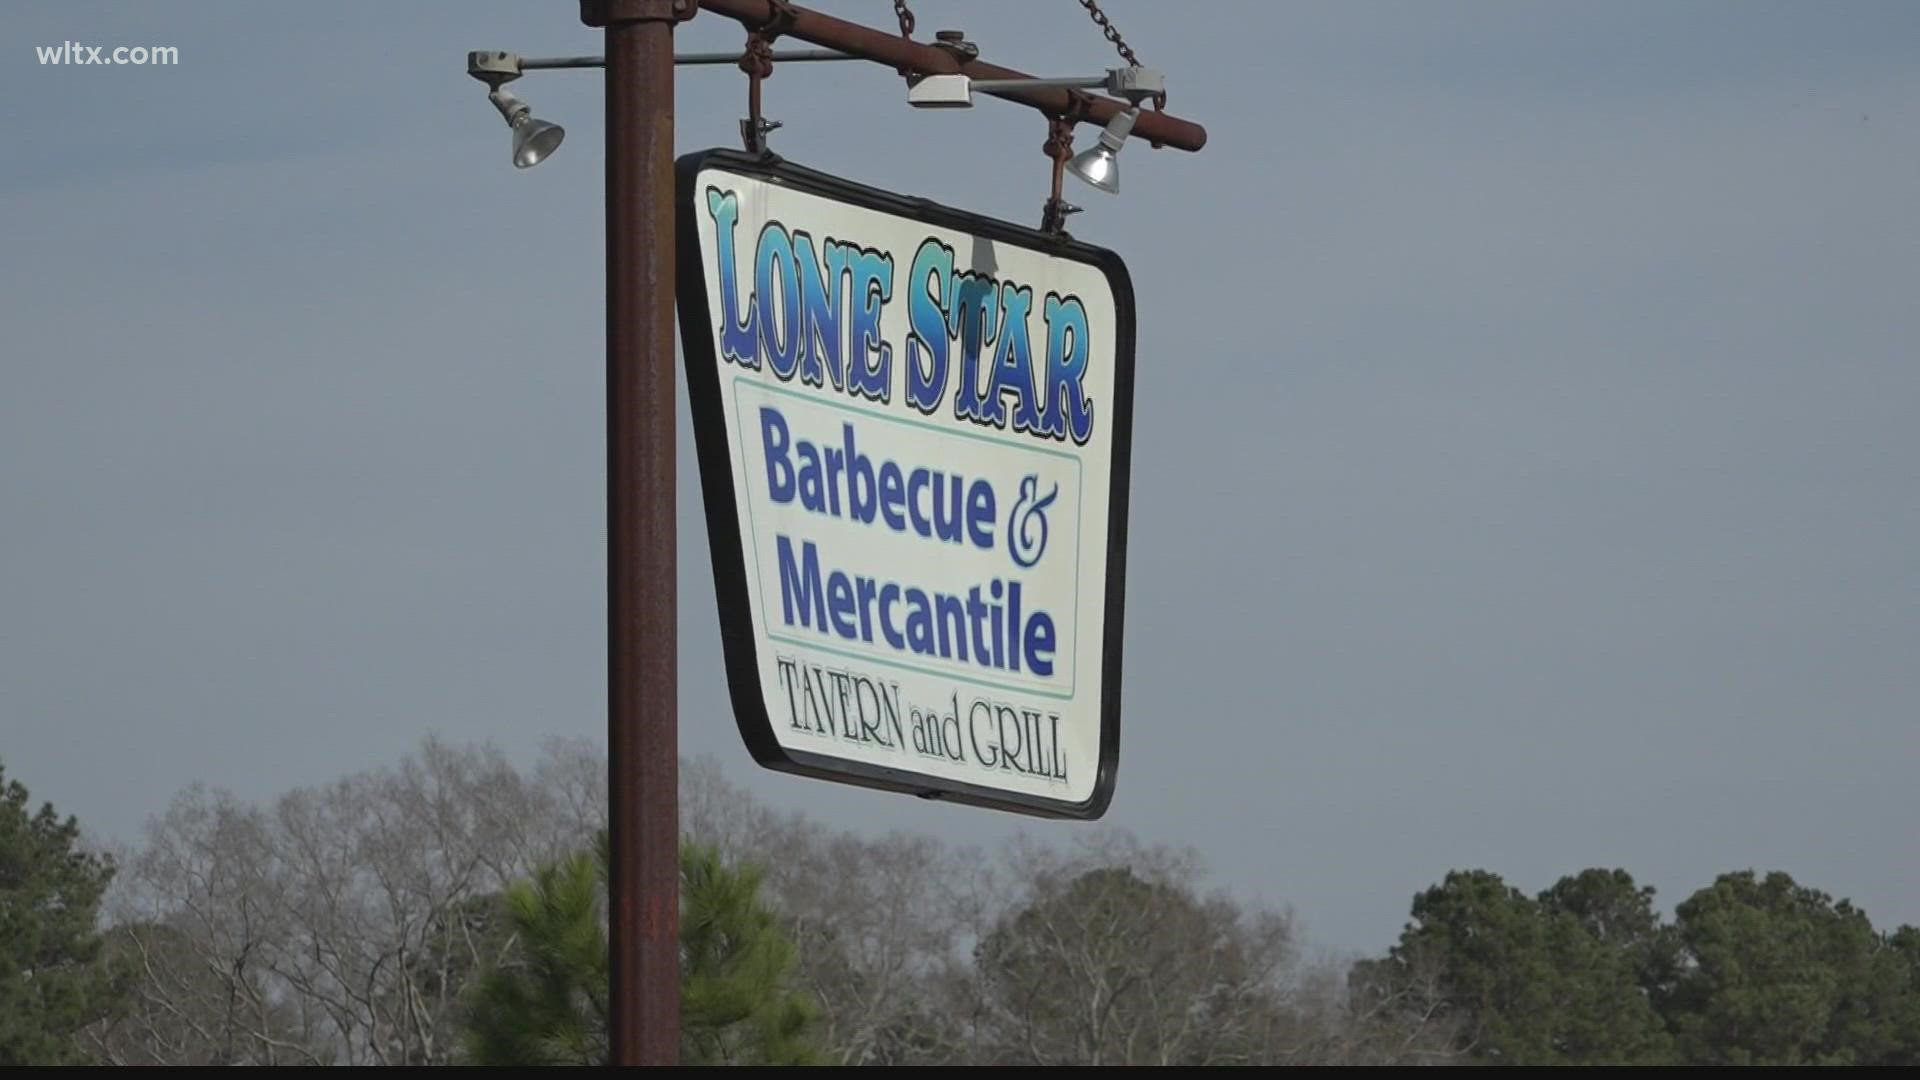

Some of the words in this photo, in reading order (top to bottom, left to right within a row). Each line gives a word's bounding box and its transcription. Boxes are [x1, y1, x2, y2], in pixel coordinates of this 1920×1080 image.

[707, 185, 894, 402] LONE
[906, 236, 1093, 445] STAR
[759, 407, 996, 549] Barbecue
[1008, 474, 1058, 568] &
[776, 534, 1056, 676] Mercantile
[777, 657, 905, 750] TAVERN
[911, 690, 966, 762] and
[969, 701, 1068, 783] GRILL
